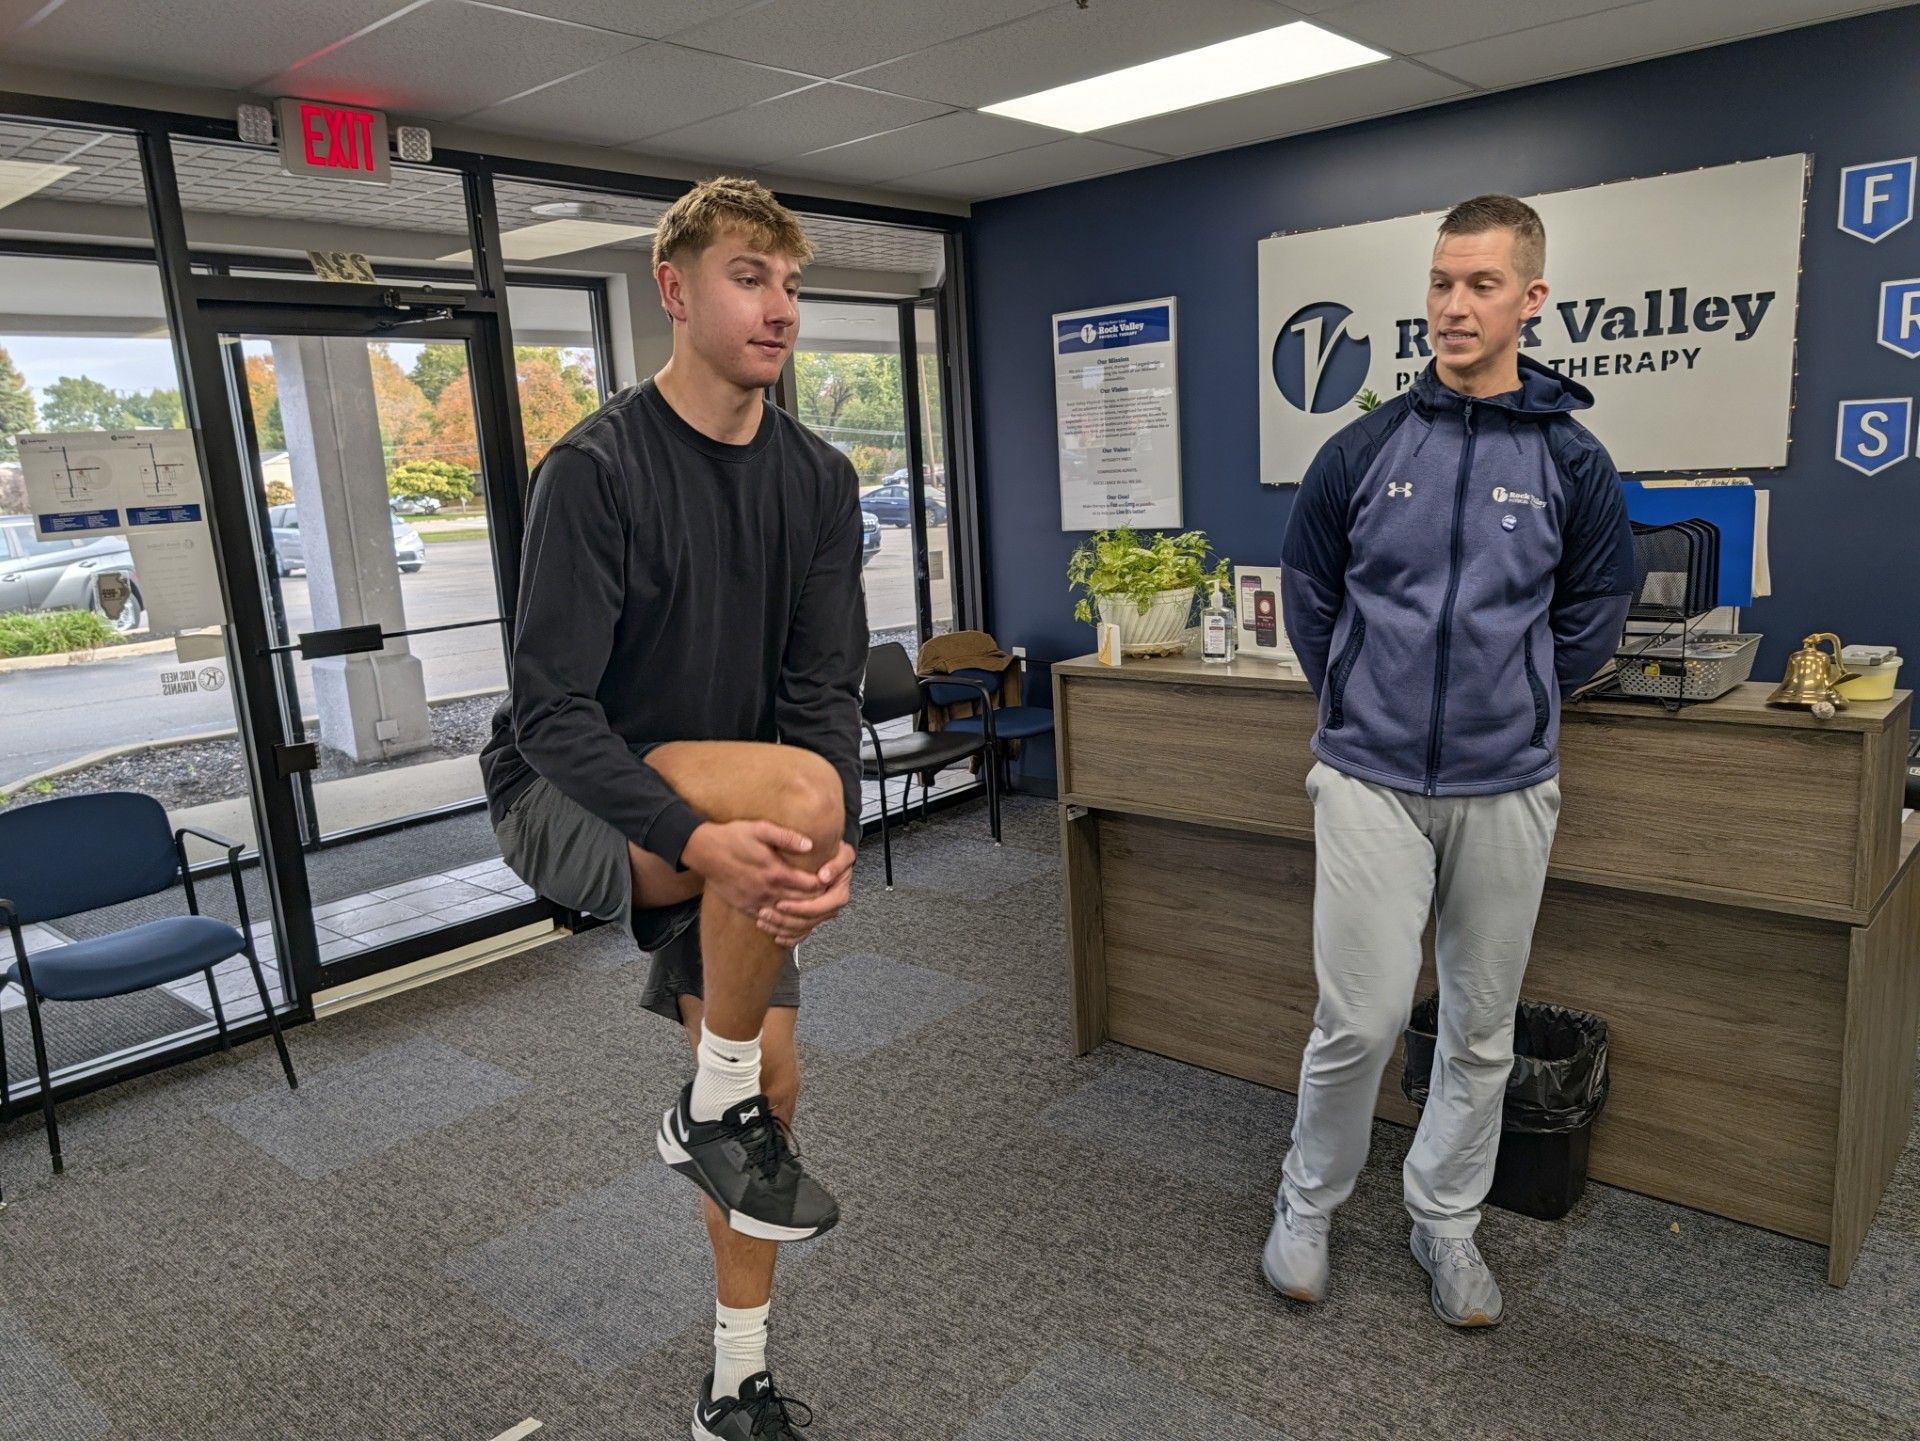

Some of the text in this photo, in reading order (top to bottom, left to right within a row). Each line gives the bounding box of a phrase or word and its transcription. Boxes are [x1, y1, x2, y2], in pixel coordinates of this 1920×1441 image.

[300, 104, 375, 172] EXIT
[1863, 173, 1893, 224] F
[1098, 325, 1119, 335] Rock
[1119, 321, 1145, 331] Valley
[1395, 286, 1776, 360] Rk Valley
[1549, 347, 1702, 378] THERAPY
[1857, 410, 1889, 457] S
